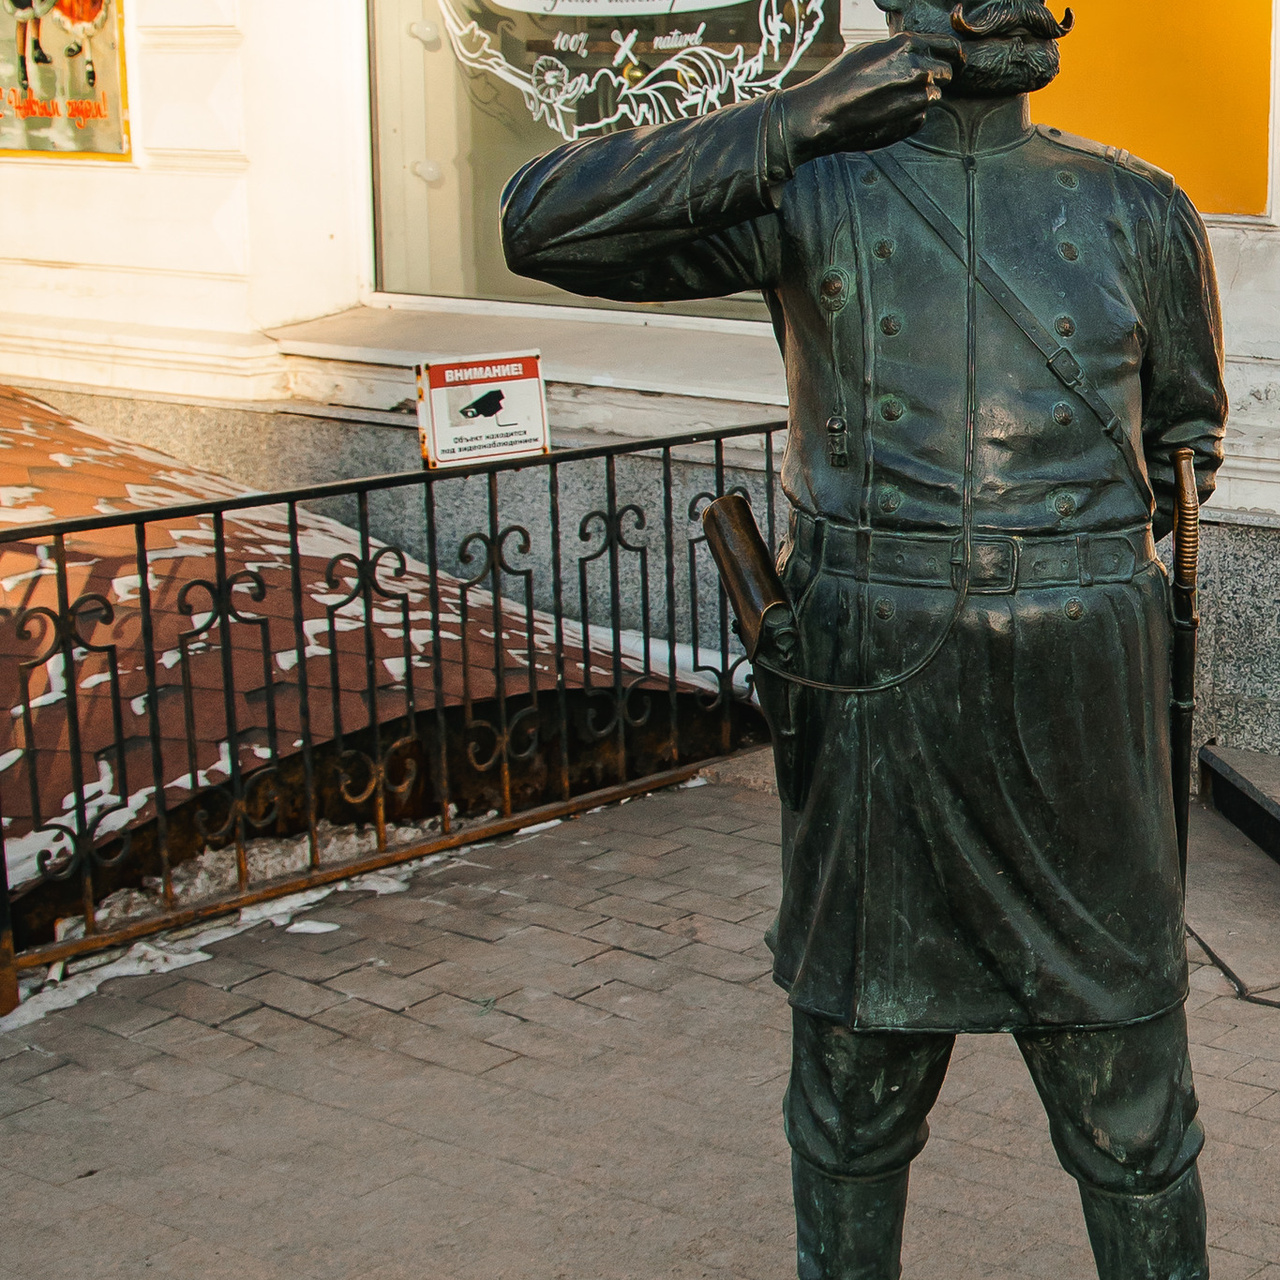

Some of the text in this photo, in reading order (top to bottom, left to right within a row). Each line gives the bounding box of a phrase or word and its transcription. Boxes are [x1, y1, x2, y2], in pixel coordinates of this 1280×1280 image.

[552, 21, 707, 59] 100% naturel
[444, 362, 524, 383] ВНИМАНИЕ!
[453, 429, 527, 445] Объект находится
